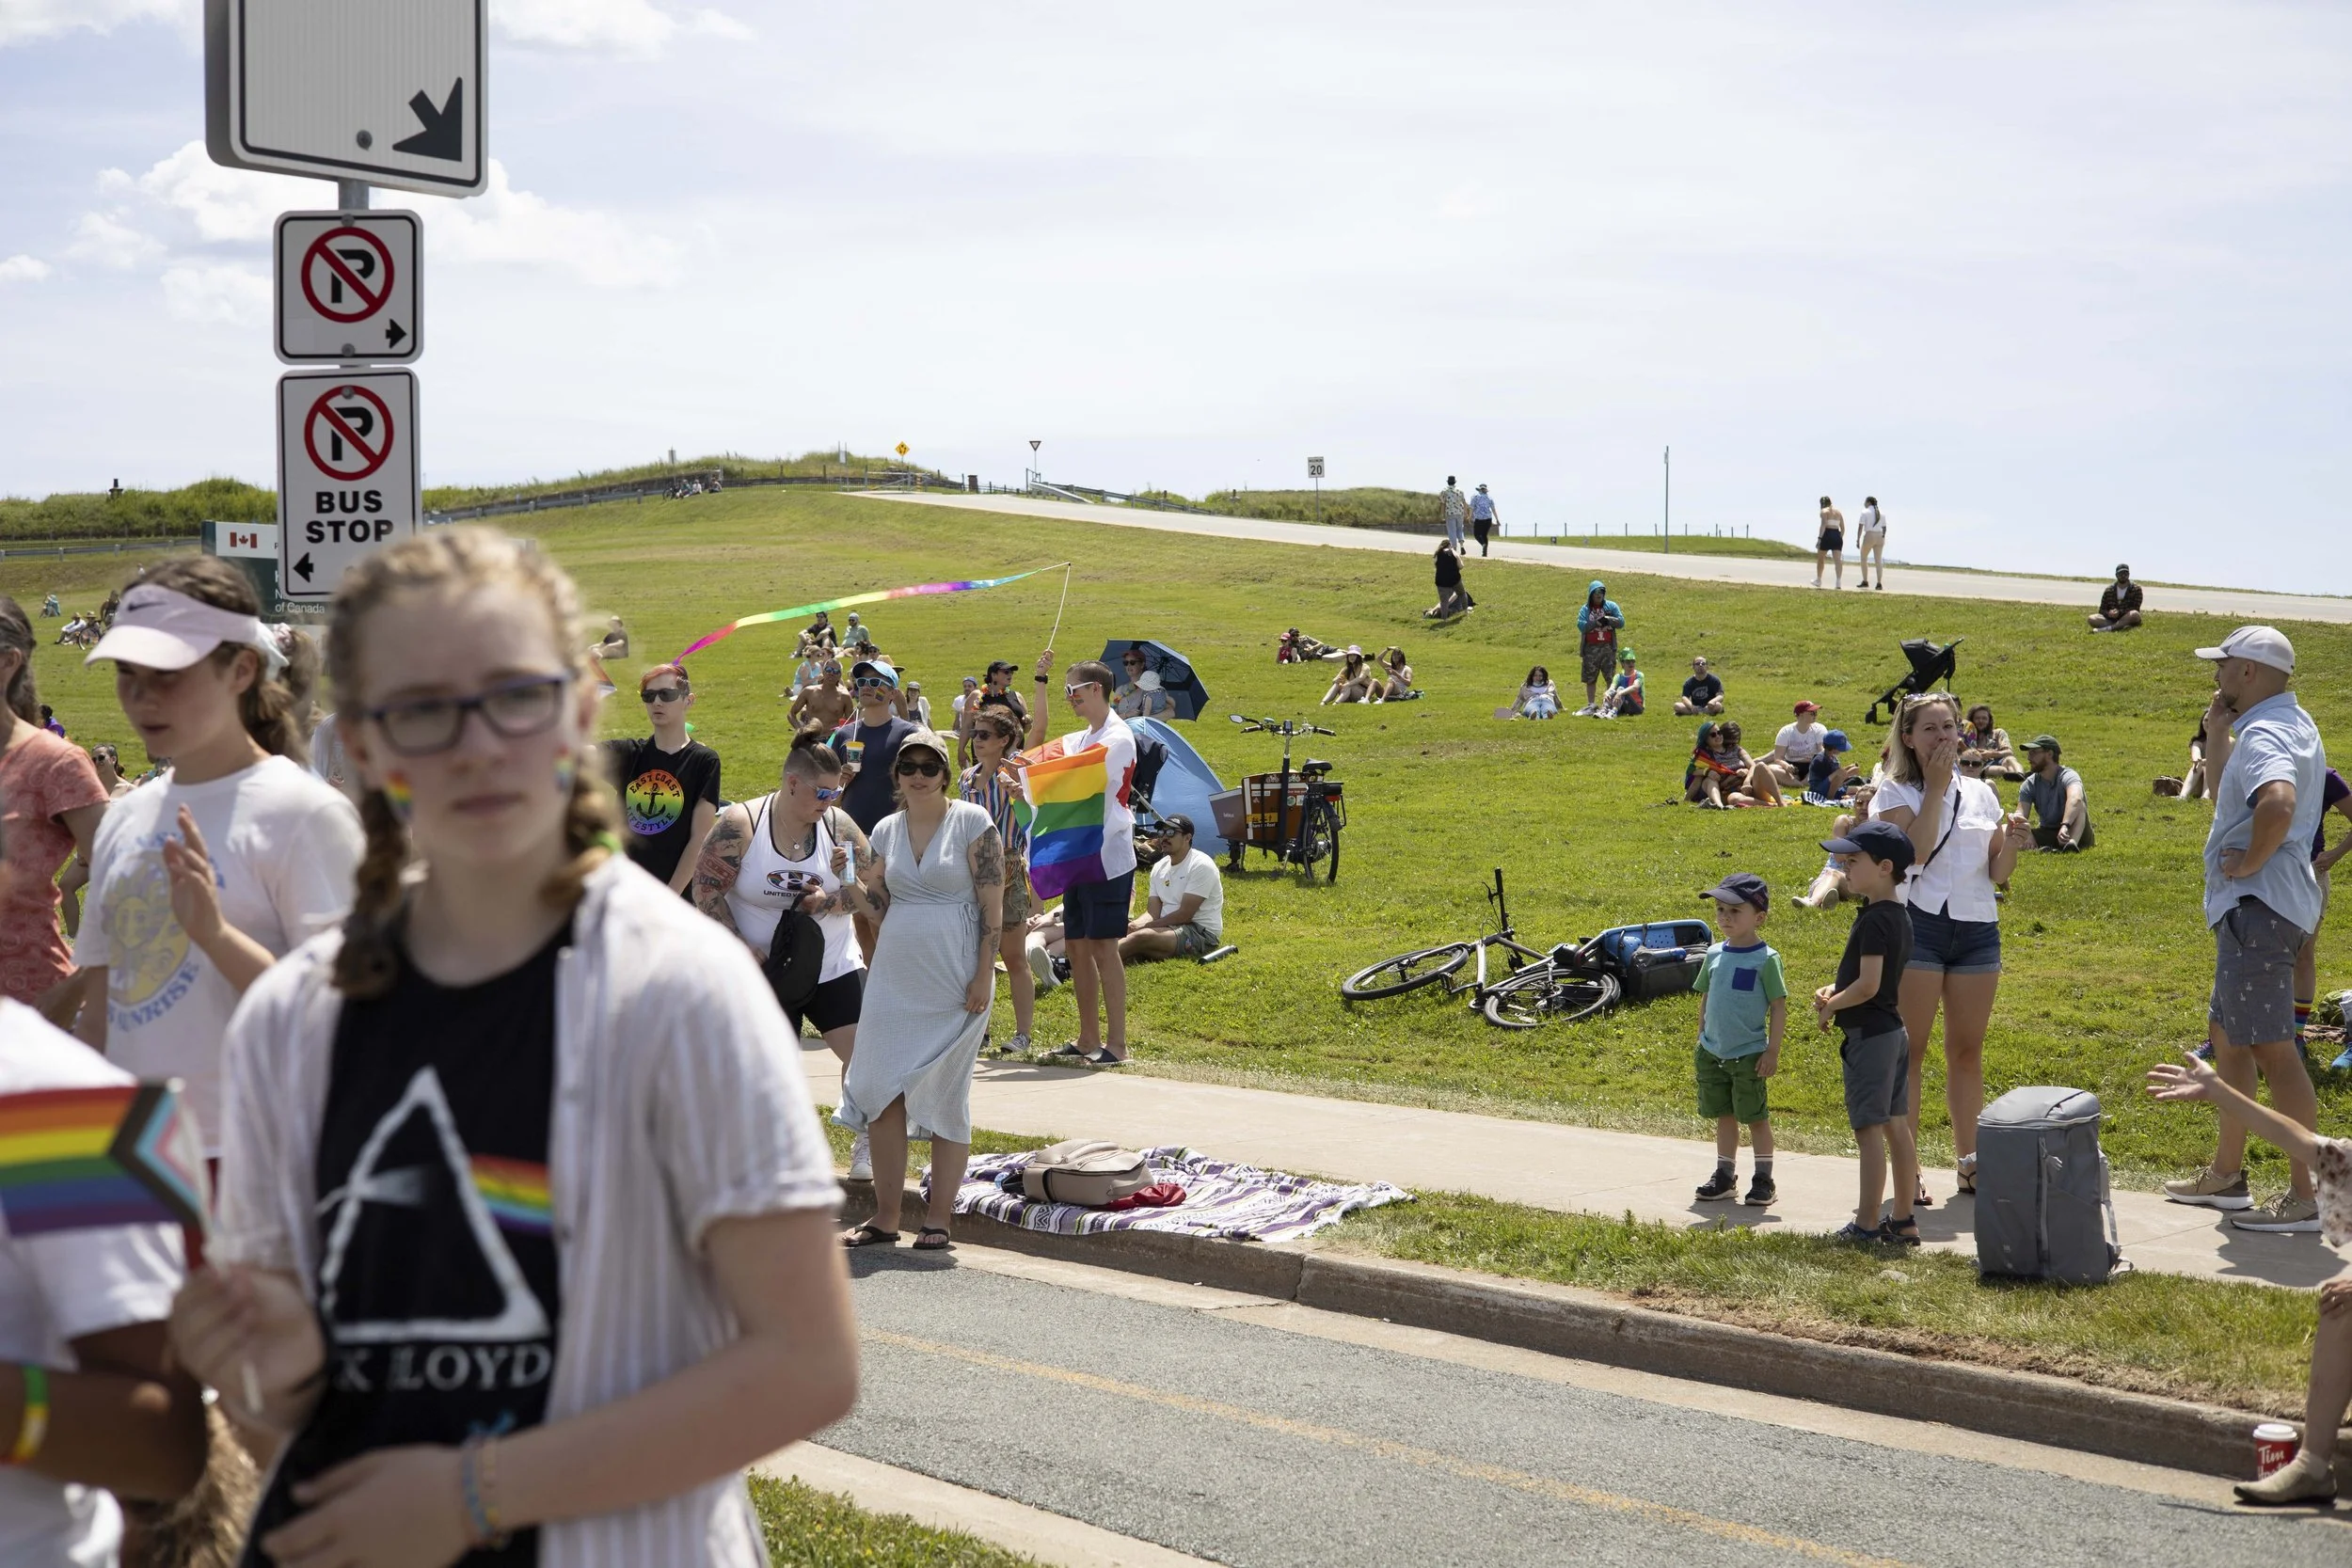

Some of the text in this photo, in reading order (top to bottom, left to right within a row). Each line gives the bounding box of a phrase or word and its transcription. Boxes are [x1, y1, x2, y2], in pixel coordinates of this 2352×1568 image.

[1311, 465, 1323, 475] 20
[315, 490, 383, 515] BUS
[306, 519, 394, 544] STOP
[275, 602, 325, 614] of Canada
[629, 772, 680, 798] EAST COAST
[387, 1344, 553, 1392] LOYD
[2258, 1444, 2285, 1465] Tim
